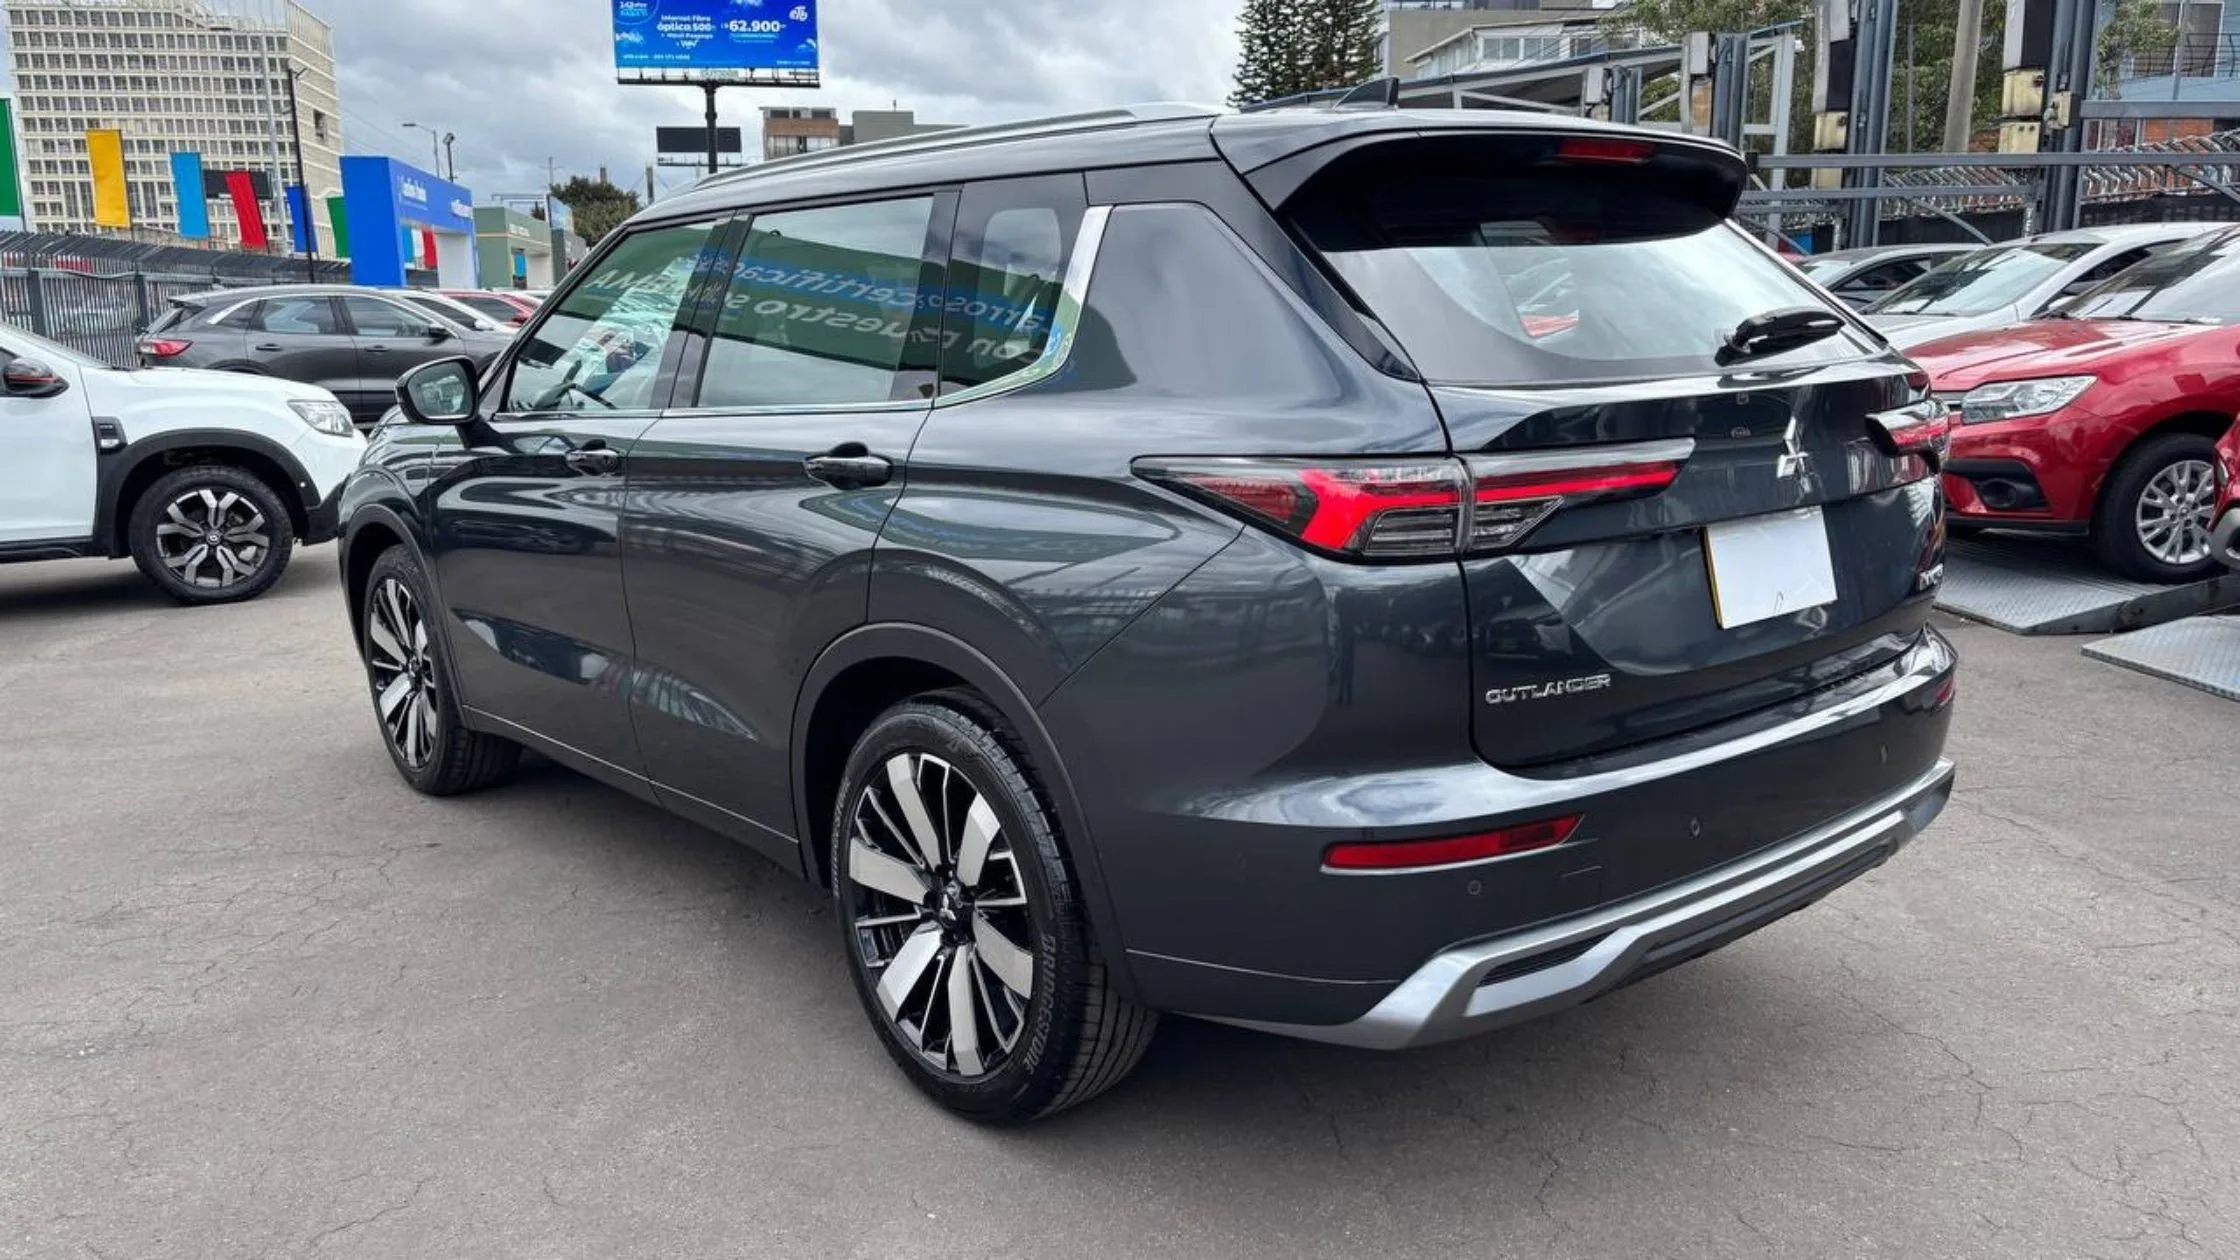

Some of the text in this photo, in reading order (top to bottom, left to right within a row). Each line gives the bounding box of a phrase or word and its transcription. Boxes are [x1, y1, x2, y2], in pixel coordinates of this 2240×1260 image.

[657, 22, 691, 32] óptica
[1485, 673, 1611, 704] OUTLANDER
[1022, 934, 1057, 1076] BRIDGESTONE
